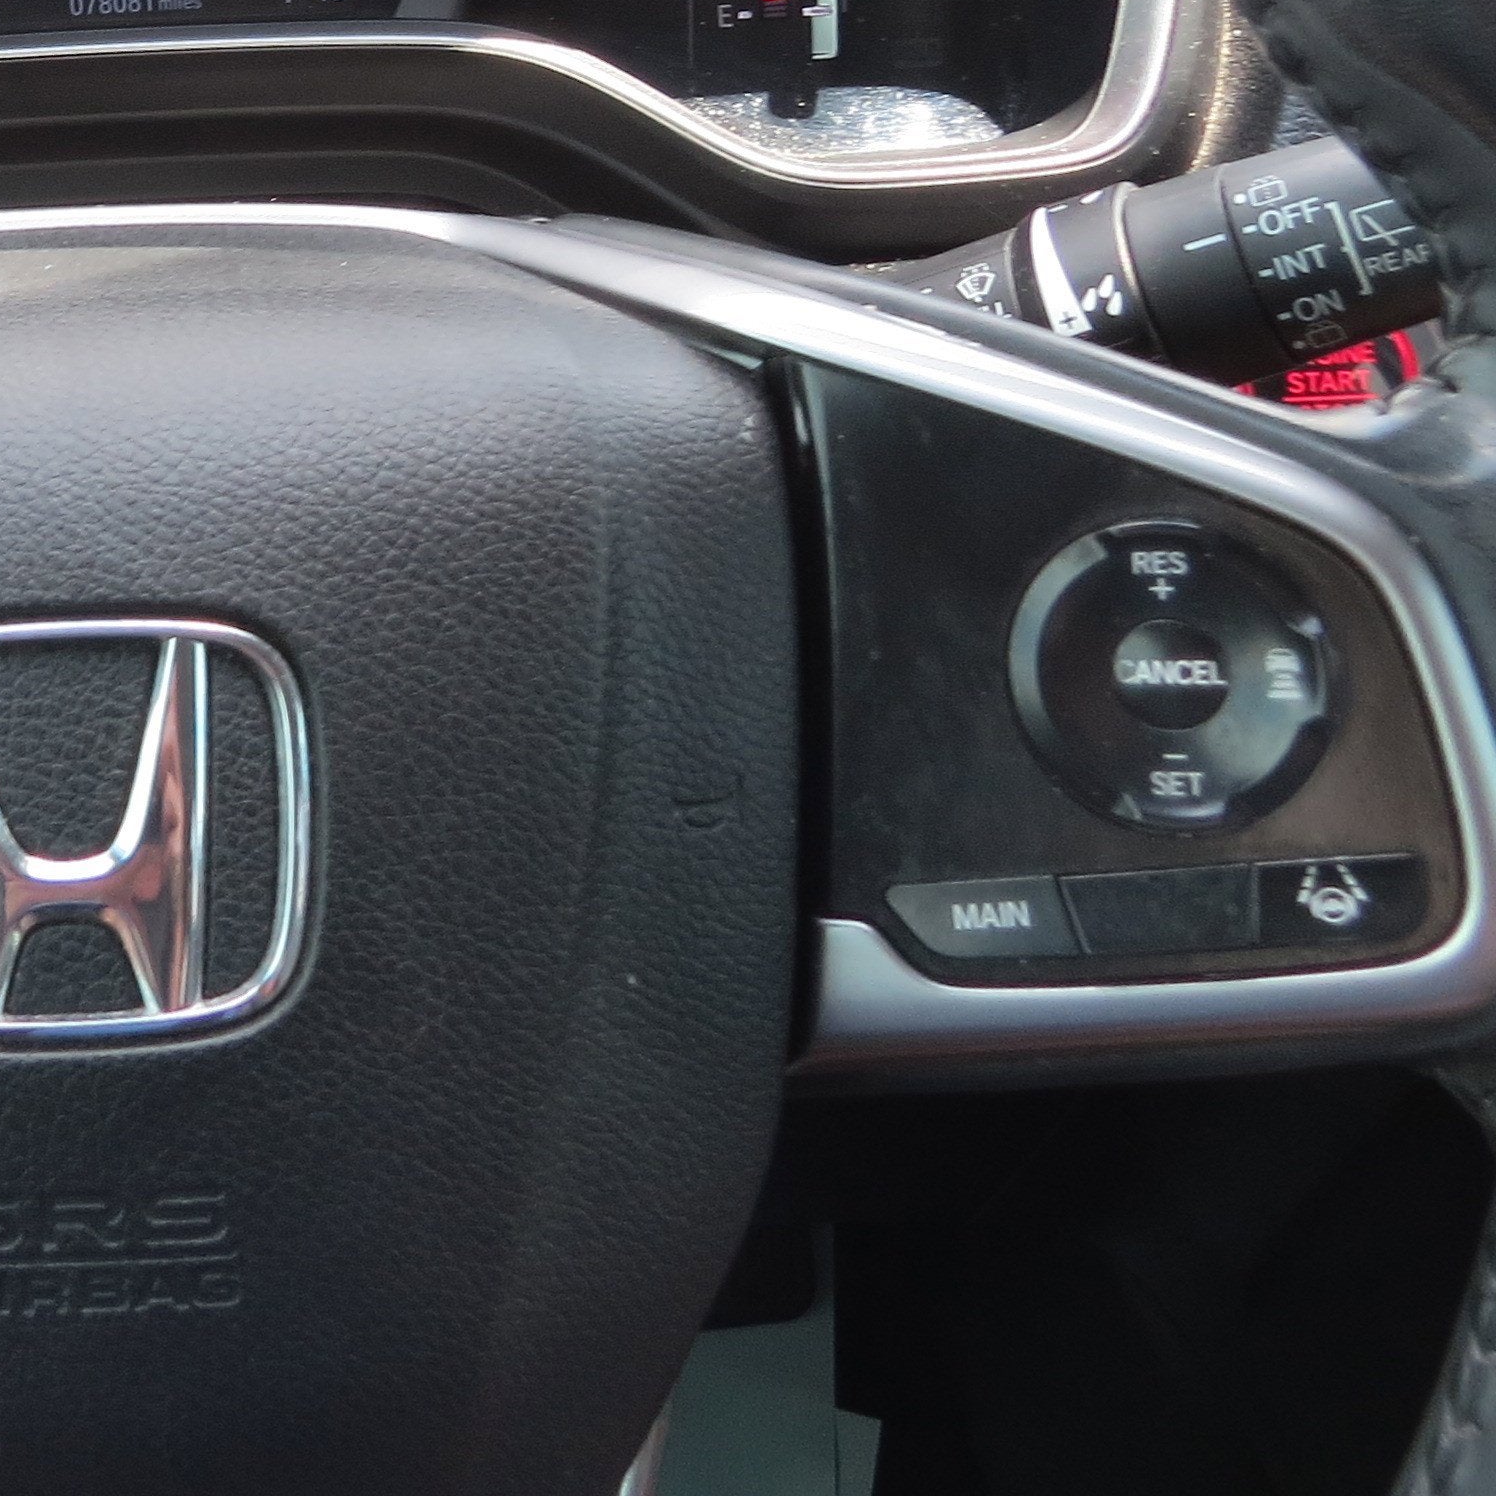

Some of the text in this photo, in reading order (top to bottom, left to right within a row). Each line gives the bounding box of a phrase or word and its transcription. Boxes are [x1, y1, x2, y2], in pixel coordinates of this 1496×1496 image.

[717, 5, 735, 28] E
[1257, 196, 1320, 236] OFF
[1272, 243, 1327, 280] INT
[1292, 289, 1346, 322] ON
[1286, 369, 1372, 396] START
[1130, 551, 1188, 576] RES
[1116, 658, 1227, 687] CANCEL
[1149, 771, 1202, 797] SET
[950, 900, 1032, 930] MAIN
